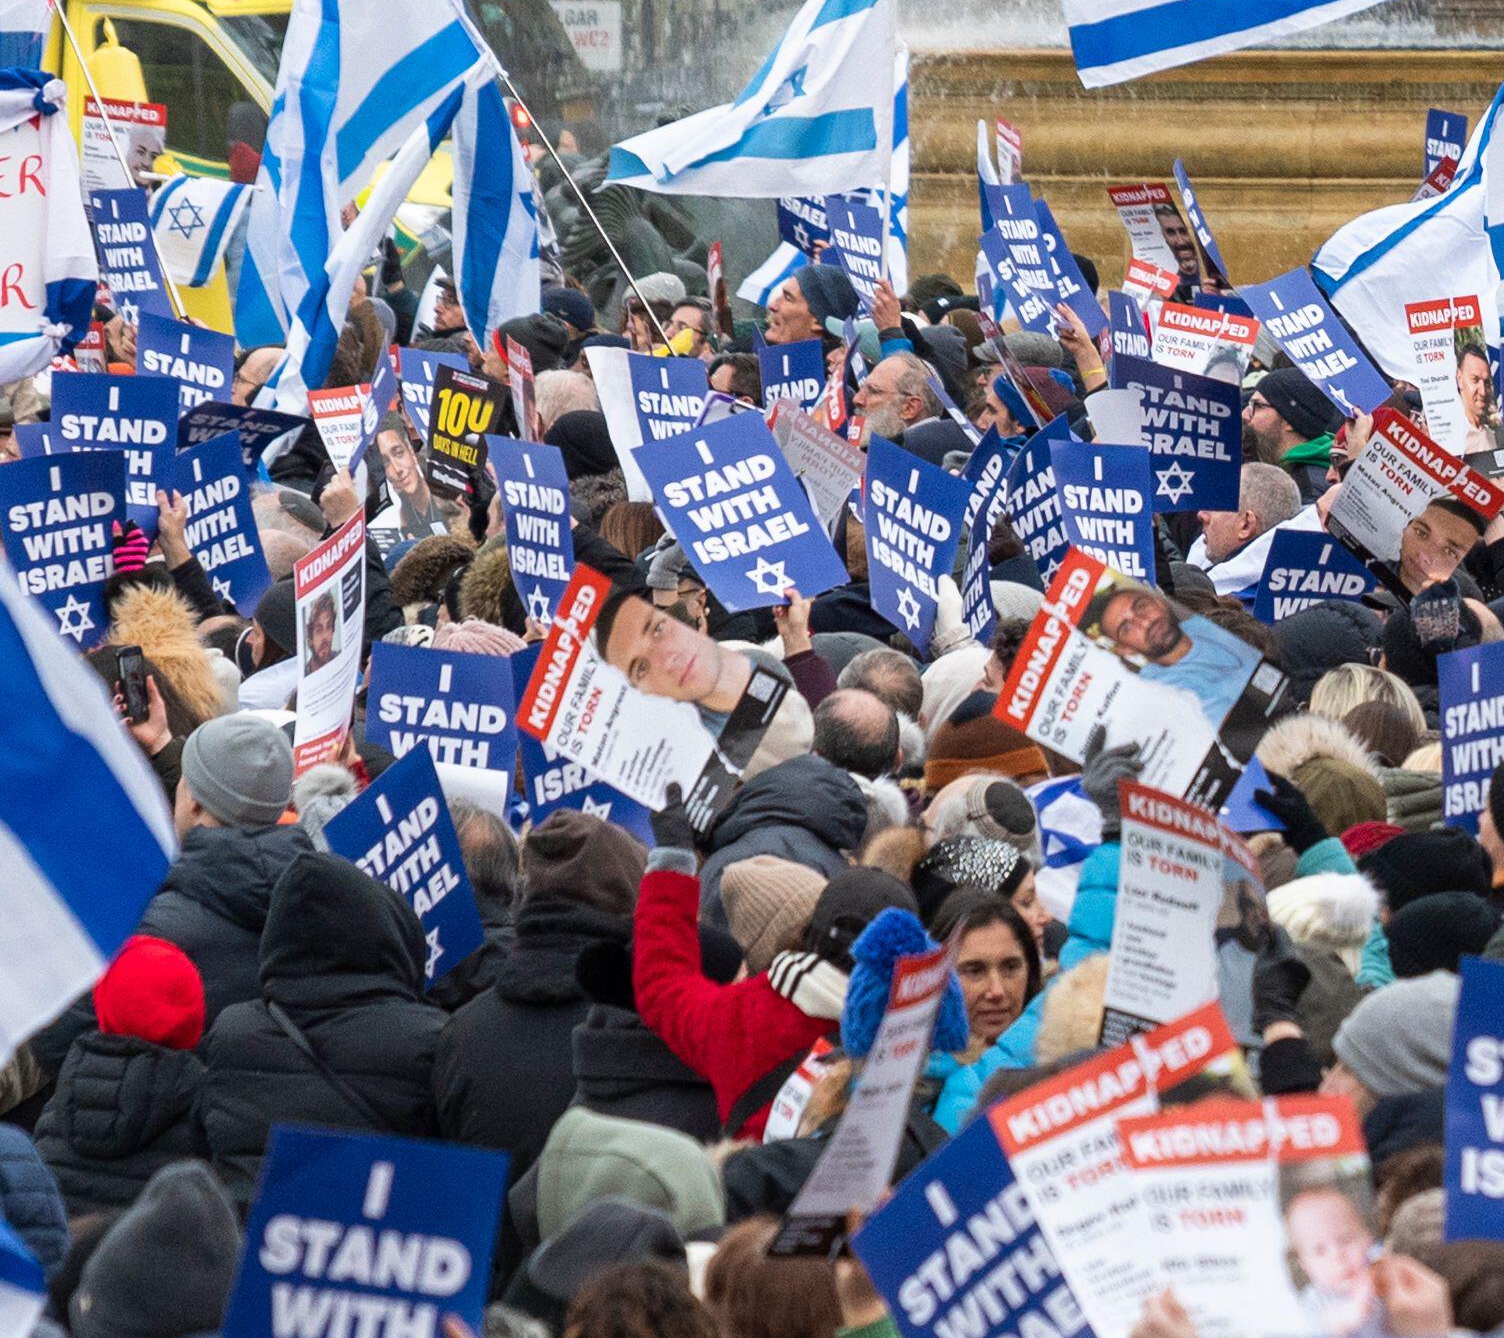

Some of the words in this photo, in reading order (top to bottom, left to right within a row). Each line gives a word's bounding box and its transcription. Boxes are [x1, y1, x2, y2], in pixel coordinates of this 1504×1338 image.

[835, 231, 881, 256] STAND
[1409, 302, 1475, 329] KIDNAPPED
[144, 354, 225, 388] STAND
[638, 392, 704, 415] STAND
[61, 417, 167, 444] STAND
[662, 455, 776, 509] STAND
[1378, 468, 1414, 498] TORN
[1385, 420, 1492, 507] KIDNAPPED
[9, 491, 115, 533] STAND
[505, 481, 565, 516] STAND
[702, 492, 783, 533] WITH
[870, 484, 951, 542] STAND
[1064, 485, 1144, 514] STAND
[22, 523, 106, 562] WITH
[516, 520, 561, 547] WITH
[692, 514, 810, 559] ISRAEL
[878, 520, 935, 570] WITH
[1074, 518, 1135, 545] WITH
[510, 552, 571, 581] ISRAEL
[1268, 567, 1367, 598] STAND
[526, 583, 597, 731] KIDNAPPED
[1006, 567, 1091, 720] KIDNAPPED
[378, 694, 507, 735] STAND
[577, 686, 604, 740] TORN
[1061, 672, 1094, 726] TORN
[1006, 1024, 1218, 1142] KIDNAPPED
[1127, 1108, 1342, 1168] KIDNAPPED
[362, 1160, 395, 1220] I
[258, 1213, 473, 1297] STAND
